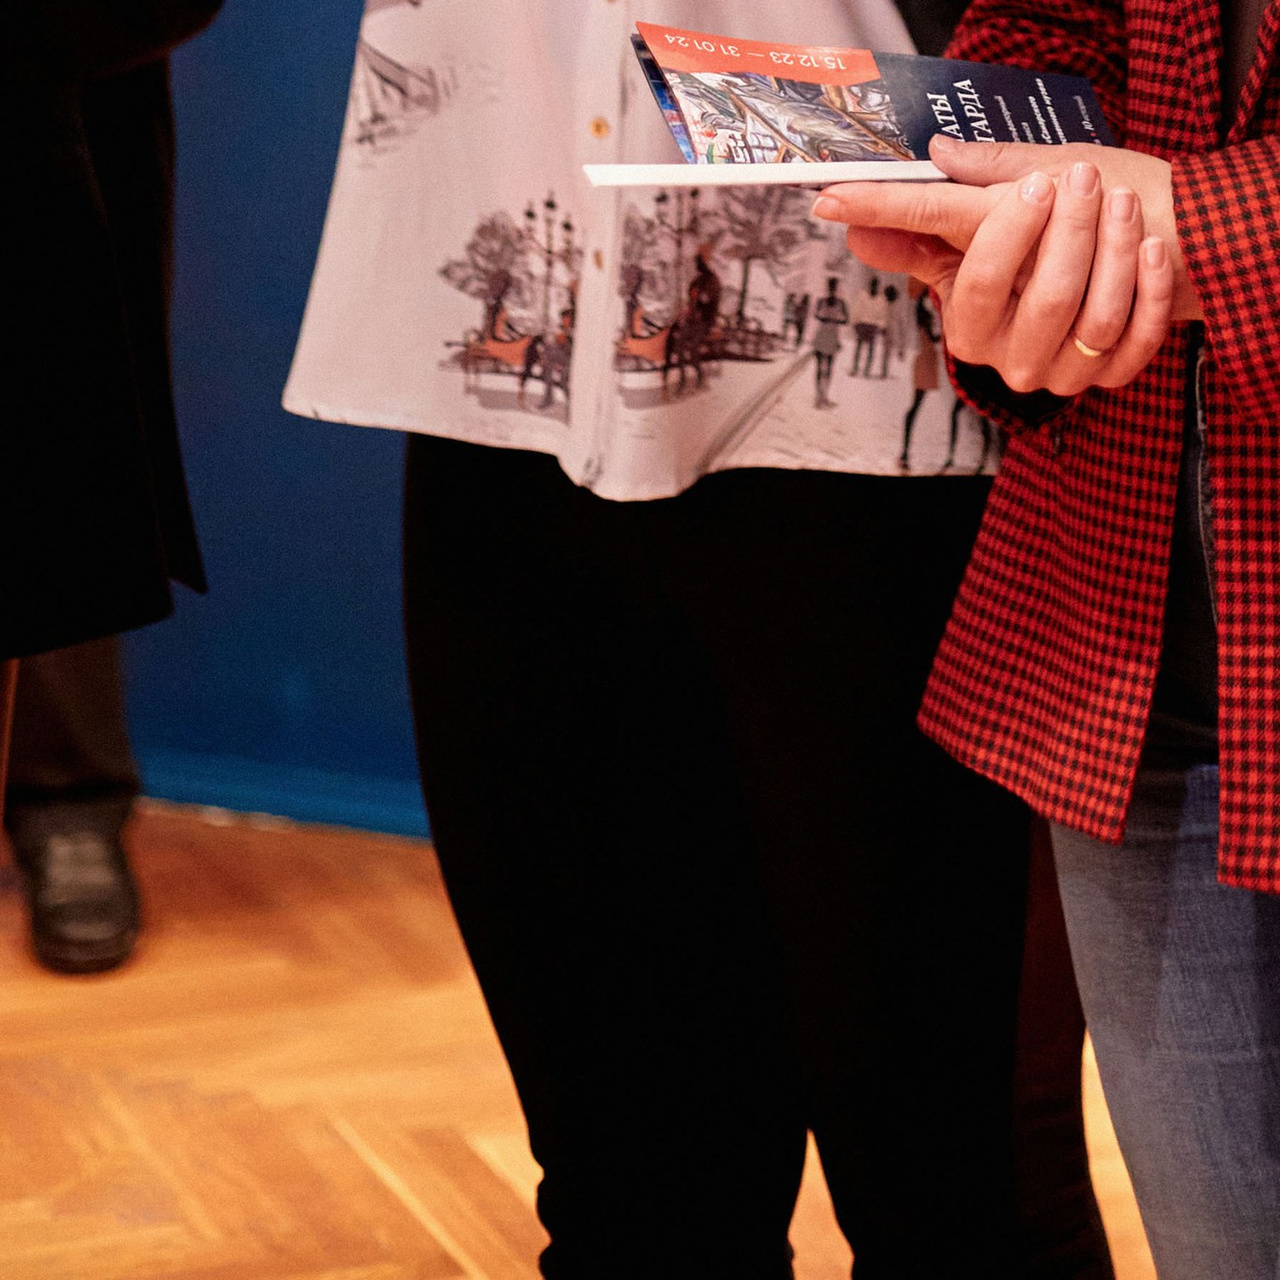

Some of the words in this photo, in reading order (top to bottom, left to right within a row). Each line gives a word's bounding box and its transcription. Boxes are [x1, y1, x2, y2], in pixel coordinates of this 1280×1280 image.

[664, 34, 741, 57] 31.01.24
[769, 51, 846, 70] 15.12.23
[927, 93, 965, 142] АТЫ
[953, 79, 995, 143] ГАРДА
